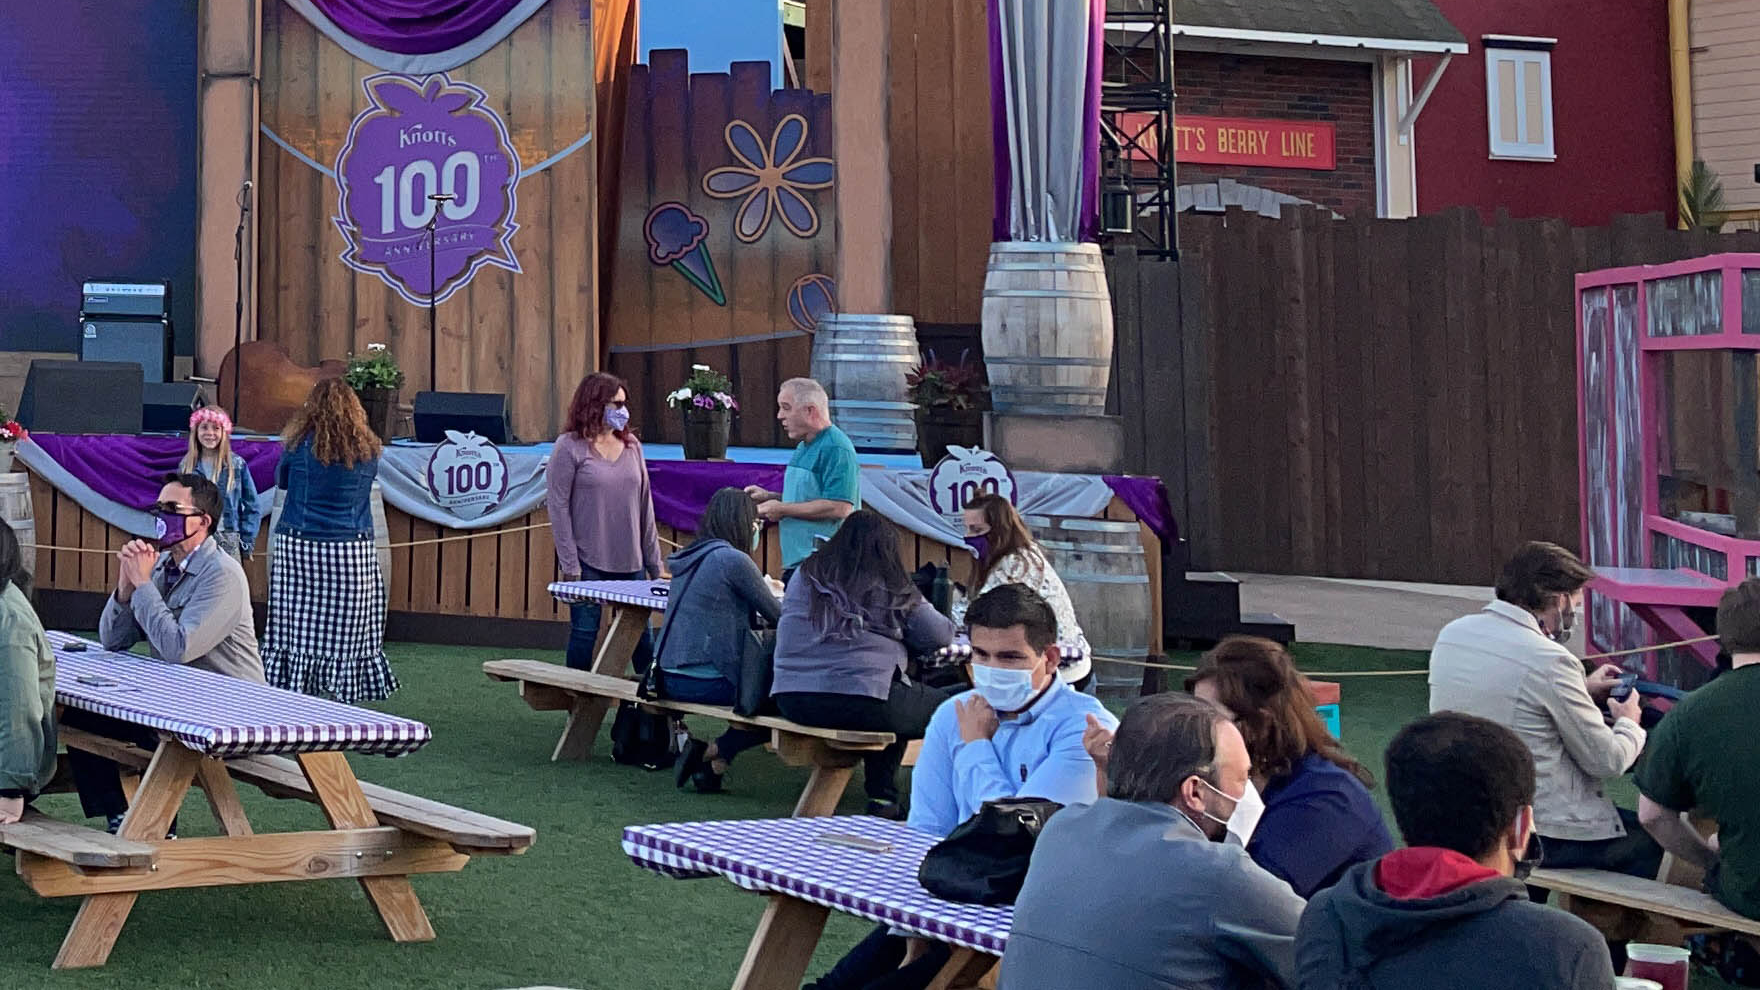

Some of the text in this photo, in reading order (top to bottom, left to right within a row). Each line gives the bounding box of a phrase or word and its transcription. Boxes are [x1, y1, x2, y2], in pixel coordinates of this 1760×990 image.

[1137, 123, 1317, 158] KNTT'S BERRY LINE
